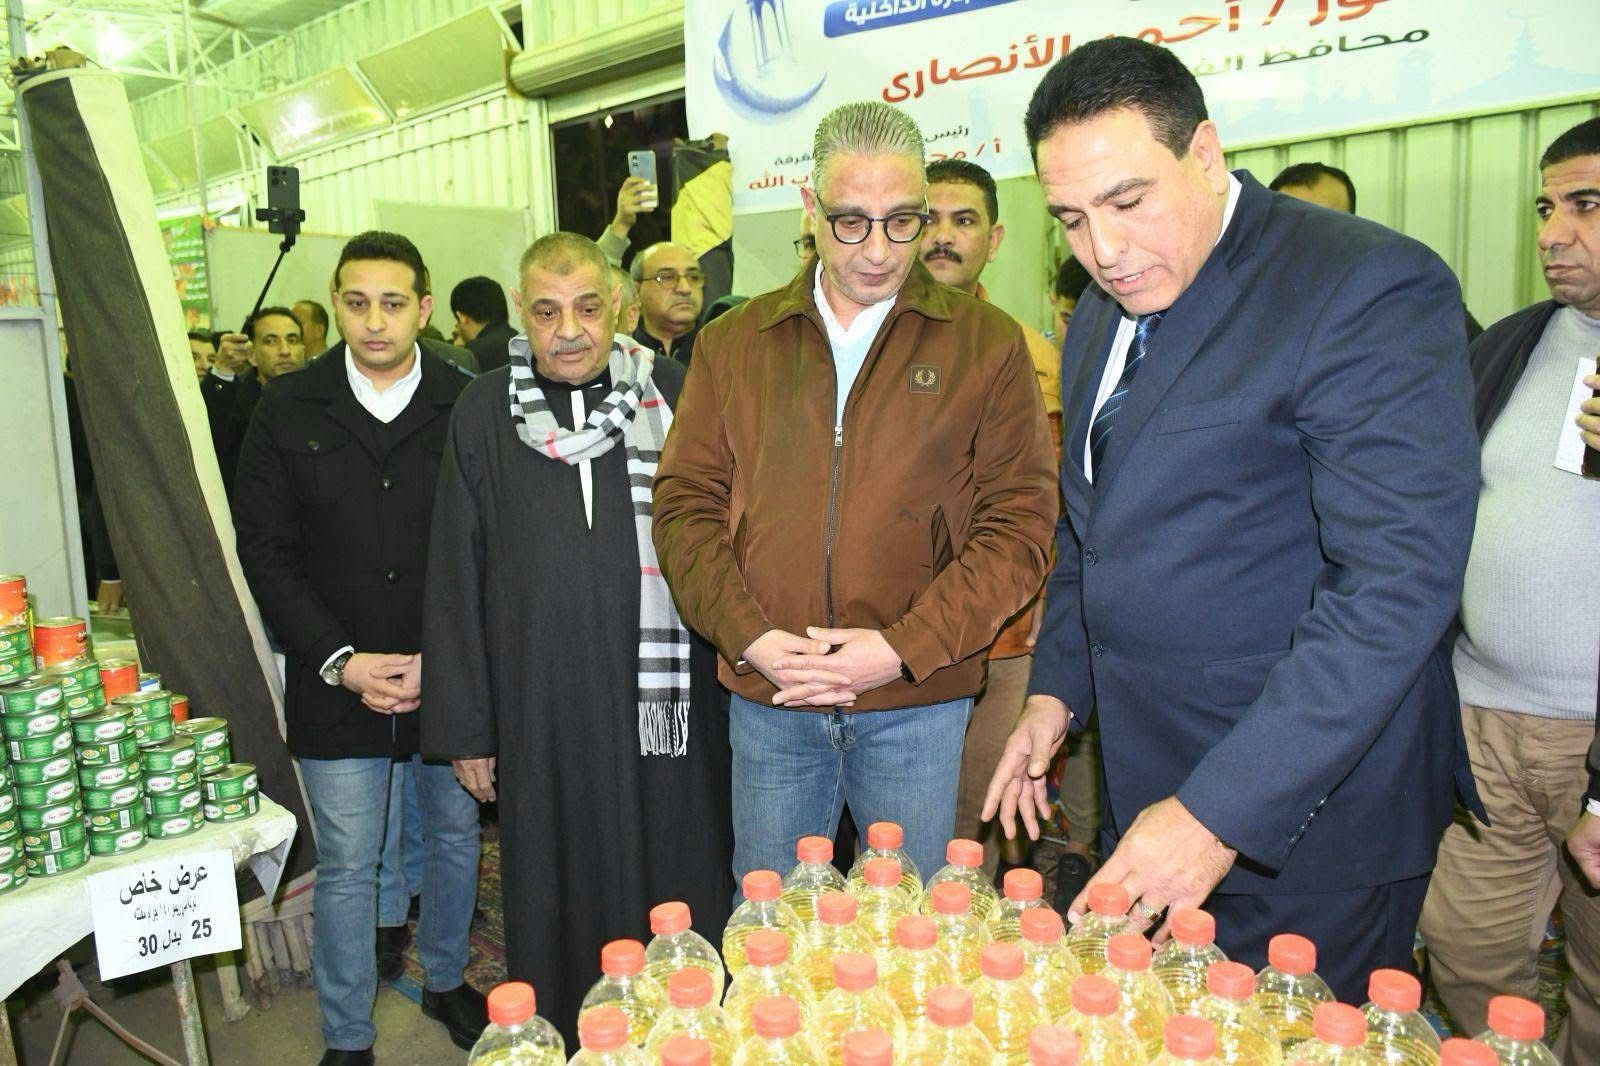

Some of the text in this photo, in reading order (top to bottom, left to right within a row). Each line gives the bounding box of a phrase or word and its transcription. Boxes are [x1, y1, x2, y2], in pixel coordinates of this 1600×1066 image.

[1105, 0, 1239, 43] أحم
[1258, 29, 1430, 66] محافظ
[925, 126, 969, 142] رئيس
[993, 137, 1001, 153] أ
[749, 170, 784, 189] الله
[120, 864, 208, 904] عرض خاص
[138, 918, 212, 956] 25 بدل 30
